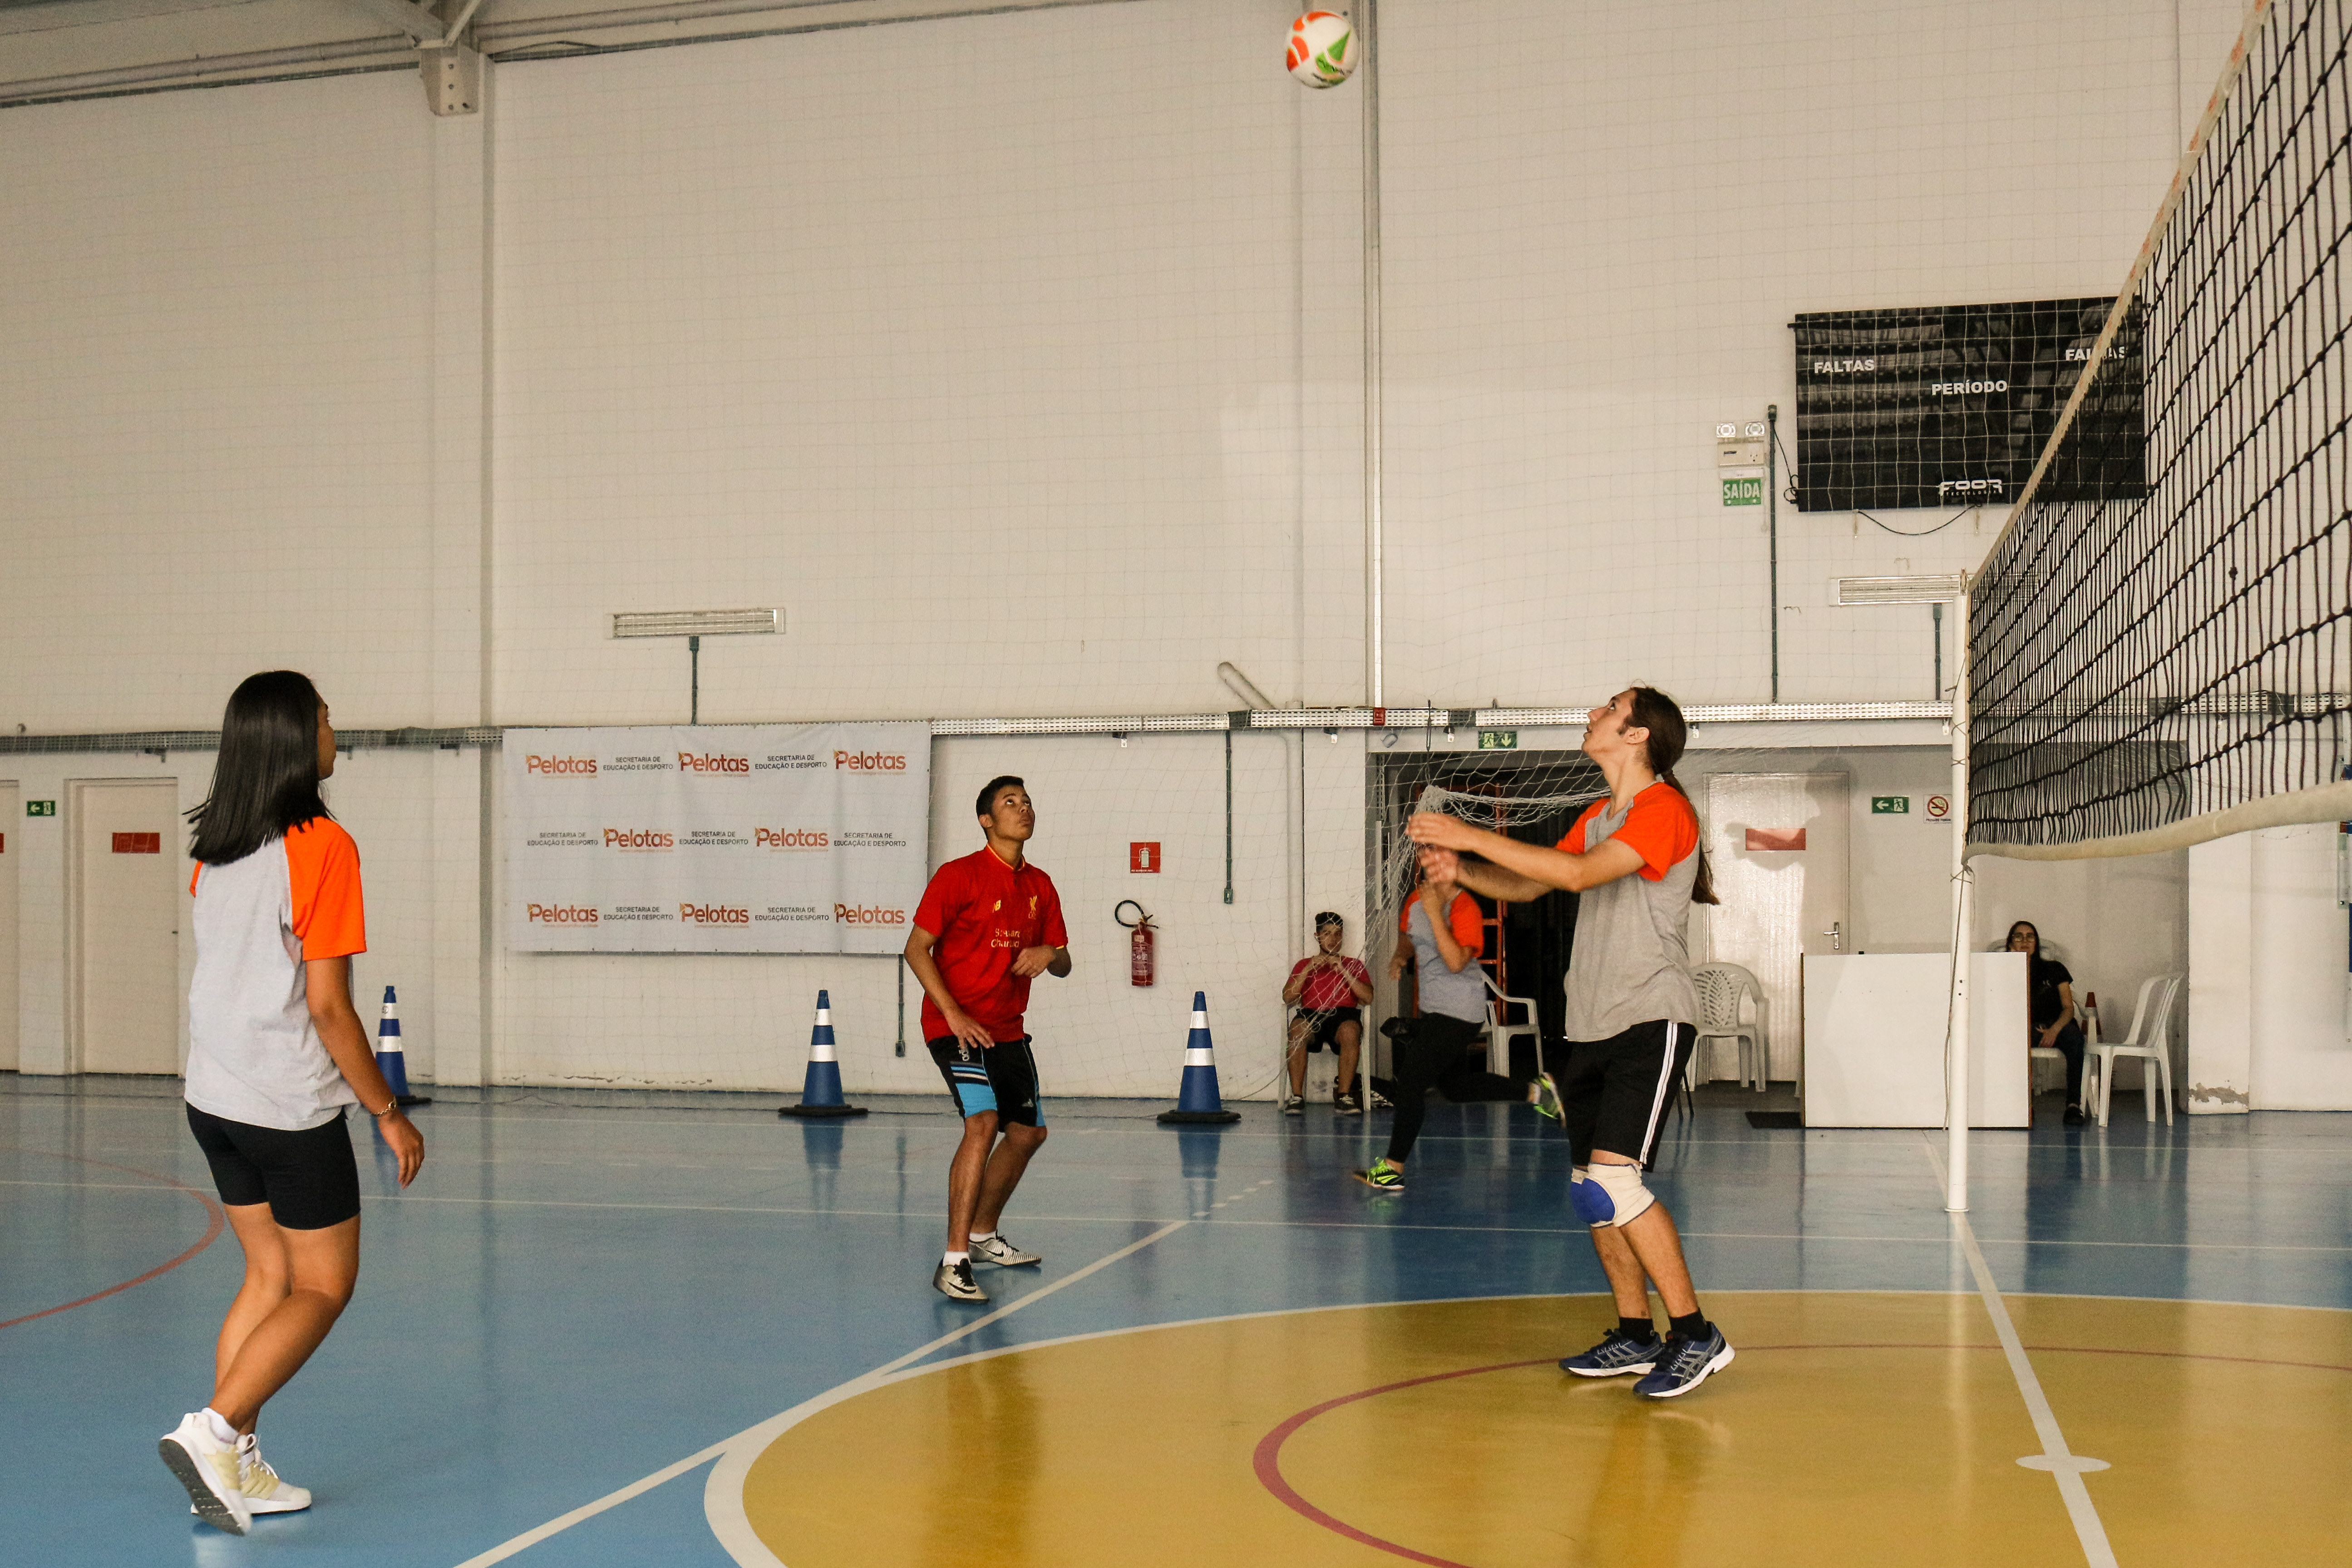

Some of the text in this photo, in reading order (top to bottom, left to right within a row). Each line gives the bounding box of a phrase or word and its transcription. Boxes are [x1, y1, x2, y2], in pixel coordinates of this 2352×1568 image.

[2066, 346, 2125, 360] FALAS
[1815, 359, 1874, 373] FALTAS
[1932, 379, 2007, 396] PERÍODO
[1723, 480, 1760, 499] SAÍDA
[526, 755, 597, 773] Pelotas
[678, 752, 749, 772] Pelotas
[833, 750, 906, 769] Pelotas
[603, 828, 673, 847] Pelotas
[755, 828, 828, 847] Pelotas
[527, 903, 598, 922] Pelotas
[679, 902, 749, 922] Pelotas
[834, 902, 905, 924] Pelotas
